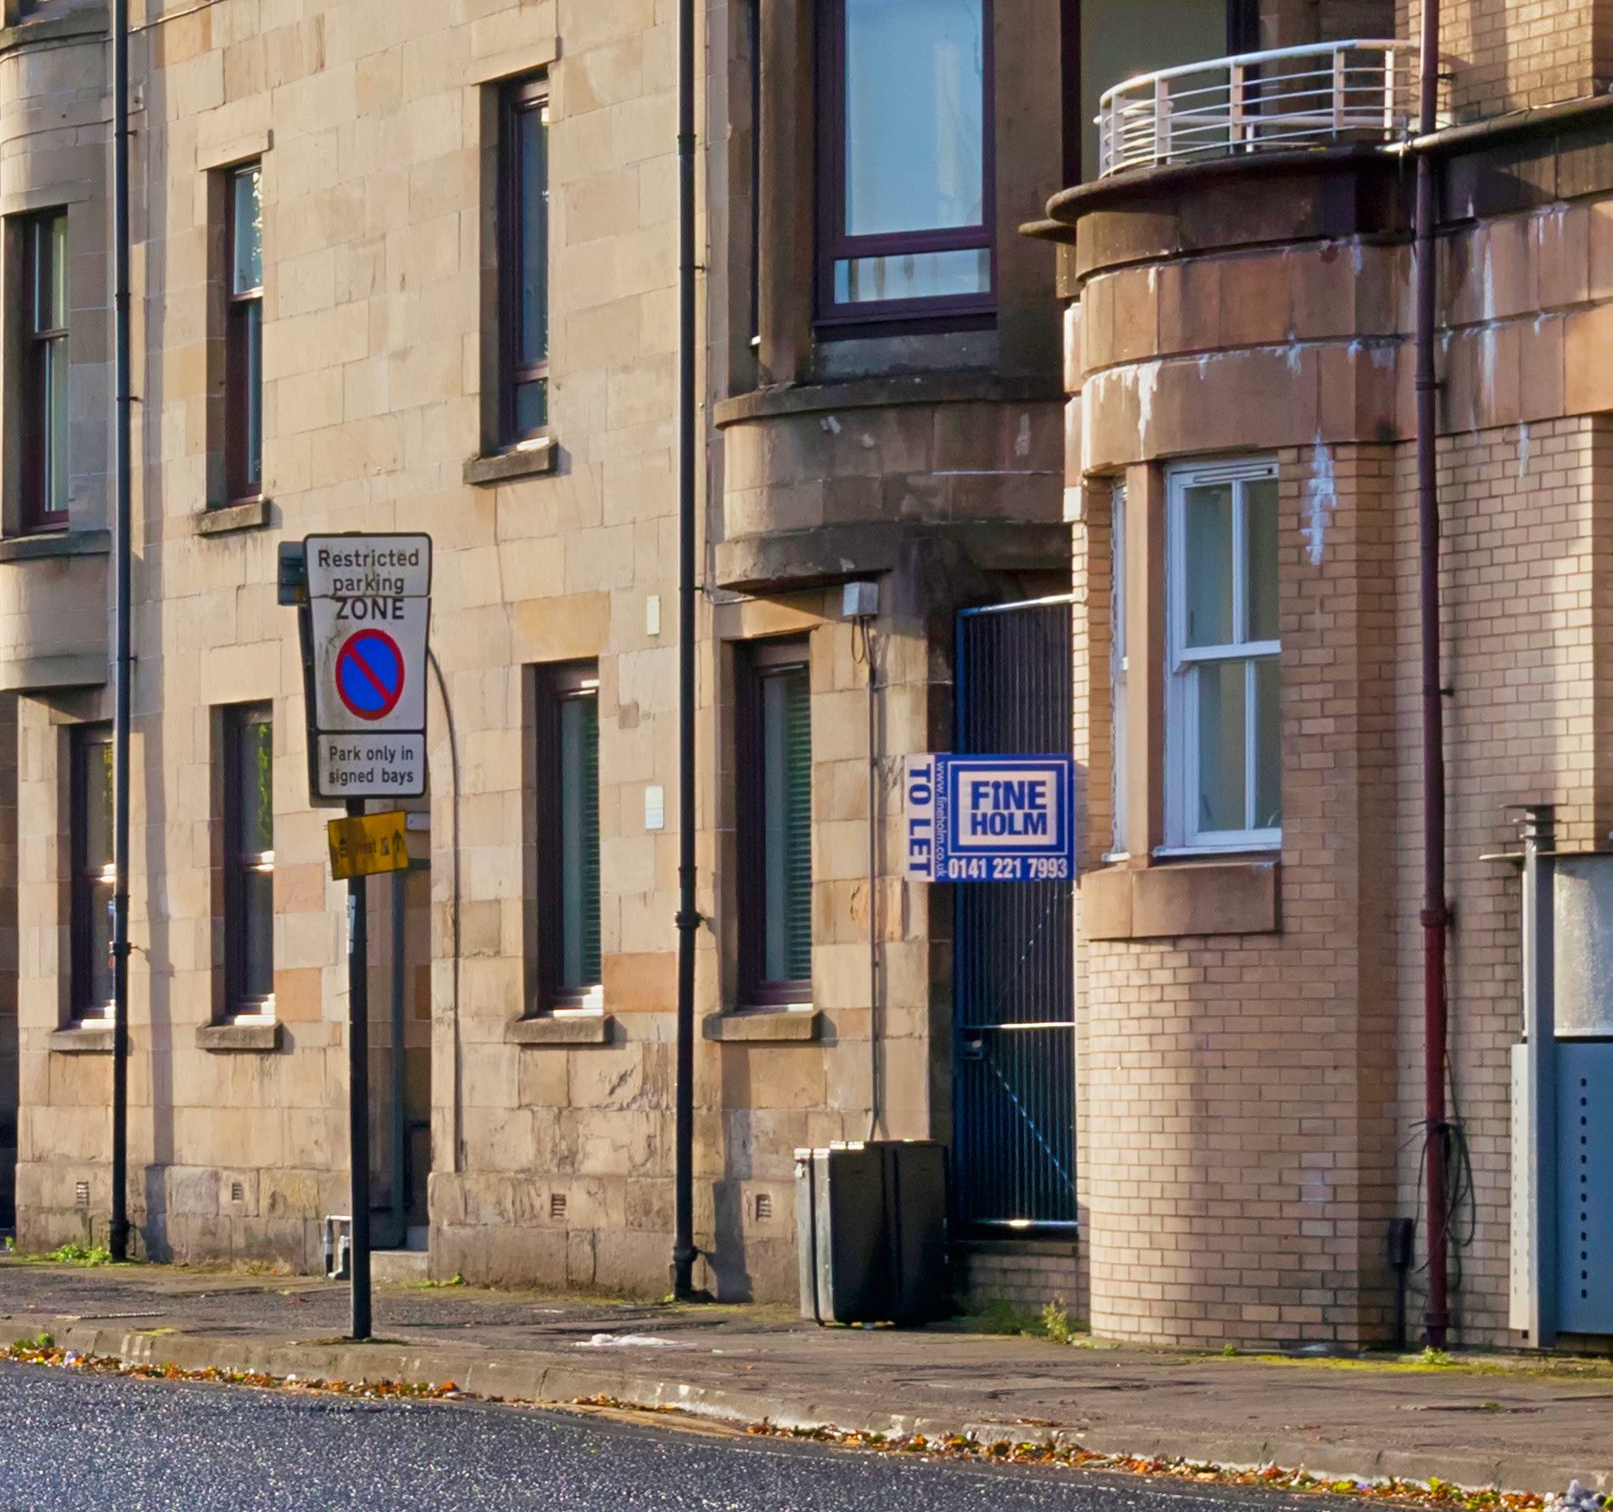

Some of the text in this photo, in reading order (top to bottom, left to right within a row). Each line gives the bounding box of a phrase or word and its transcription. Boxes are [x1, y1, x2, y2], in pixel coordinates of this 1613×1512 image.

[317, 548, 419, 568] Restricted
[332, 573, 405, 595] parking
[335, 597, 405, 620] ZONE
[329, 745, 414, 764] Park only in
[328, 767, 414, 786] signed bays
[908, 763, 932, 877] TO LET
[936, 761, 948, 878] www.fineholm.co.uk
[970, 811, 1048, 836] HOLM
[948, 857, 1068, 879] 0141 221 7993
